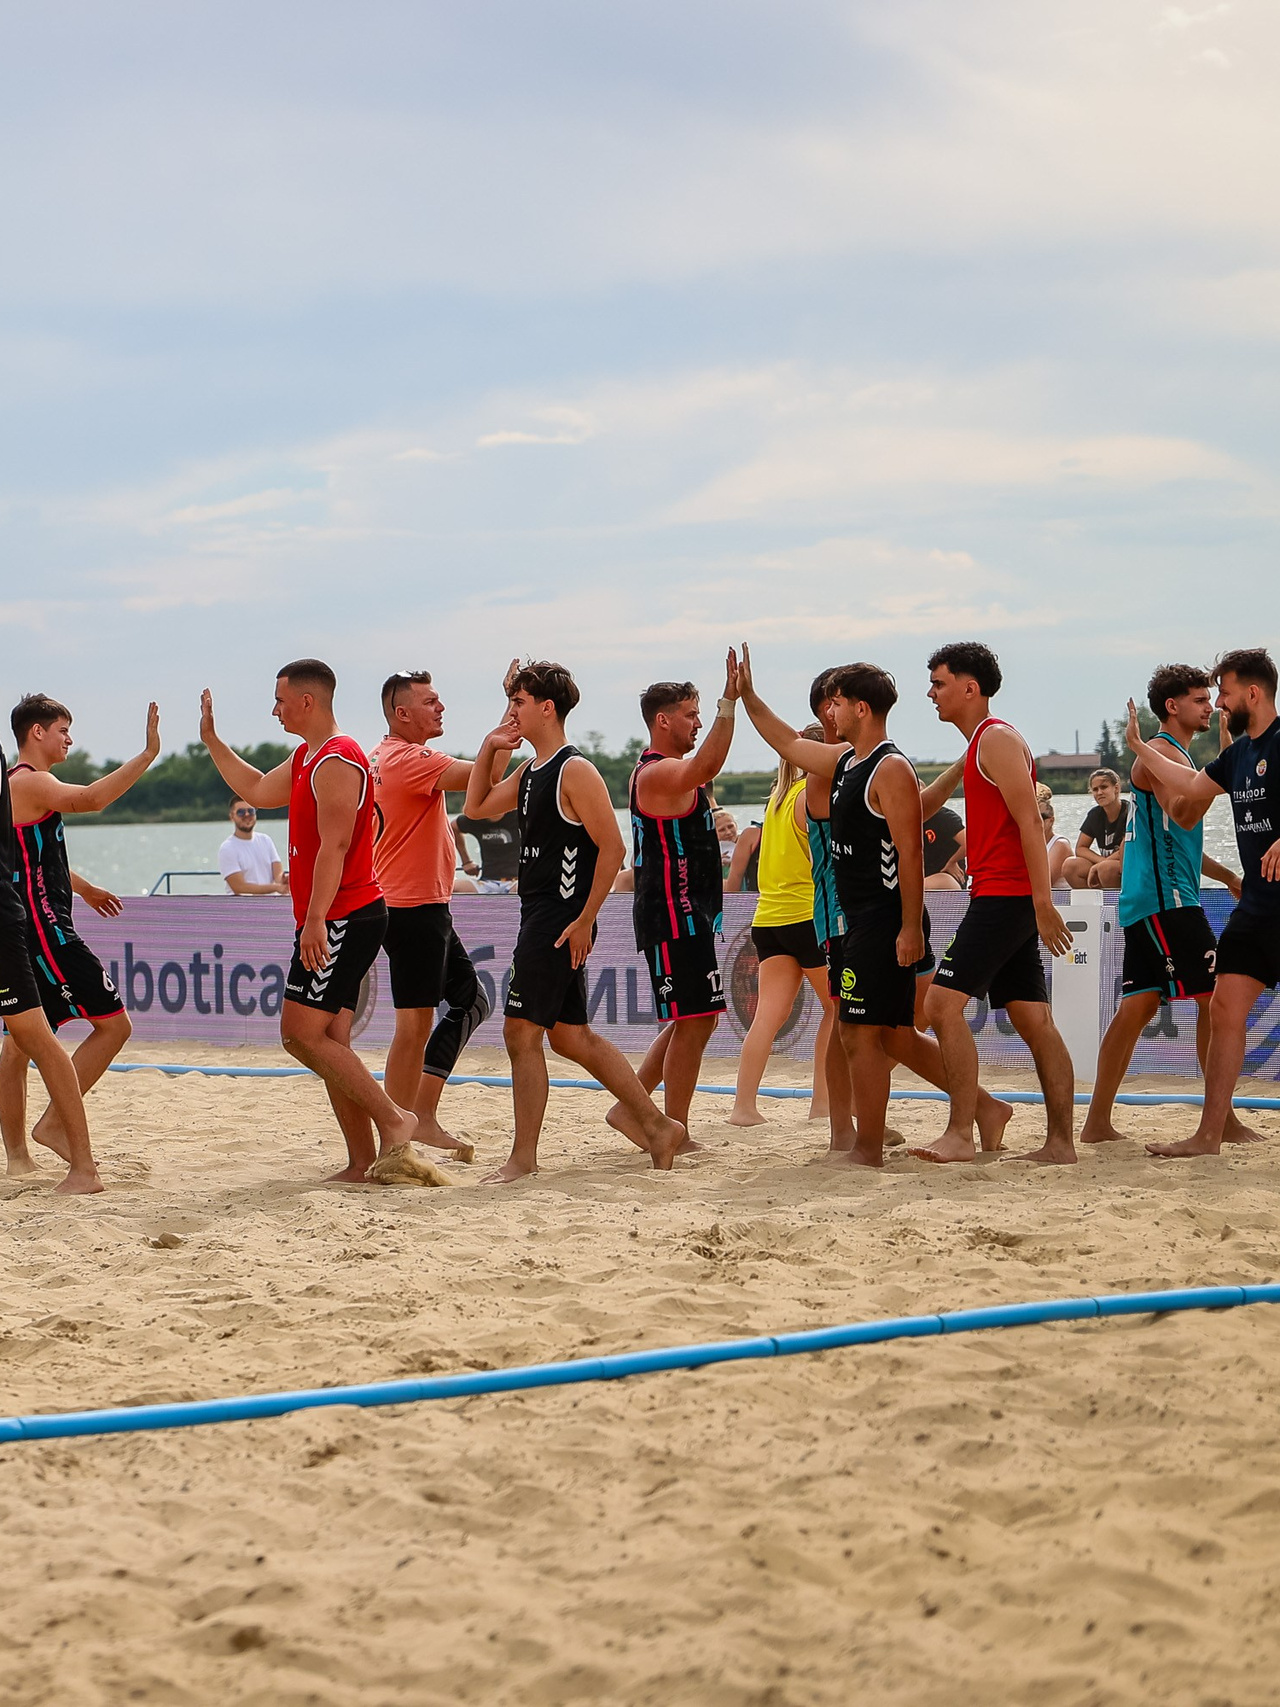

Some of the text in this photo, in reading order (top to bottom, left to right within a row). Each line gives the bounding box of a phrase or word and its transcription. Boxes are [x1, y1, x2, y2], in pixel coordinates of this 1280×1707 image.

[111, 942, 285, 1016] botica
[0, 997, 18, 1006] JAKO
[848, 1006, 866, 1014] JAKO
